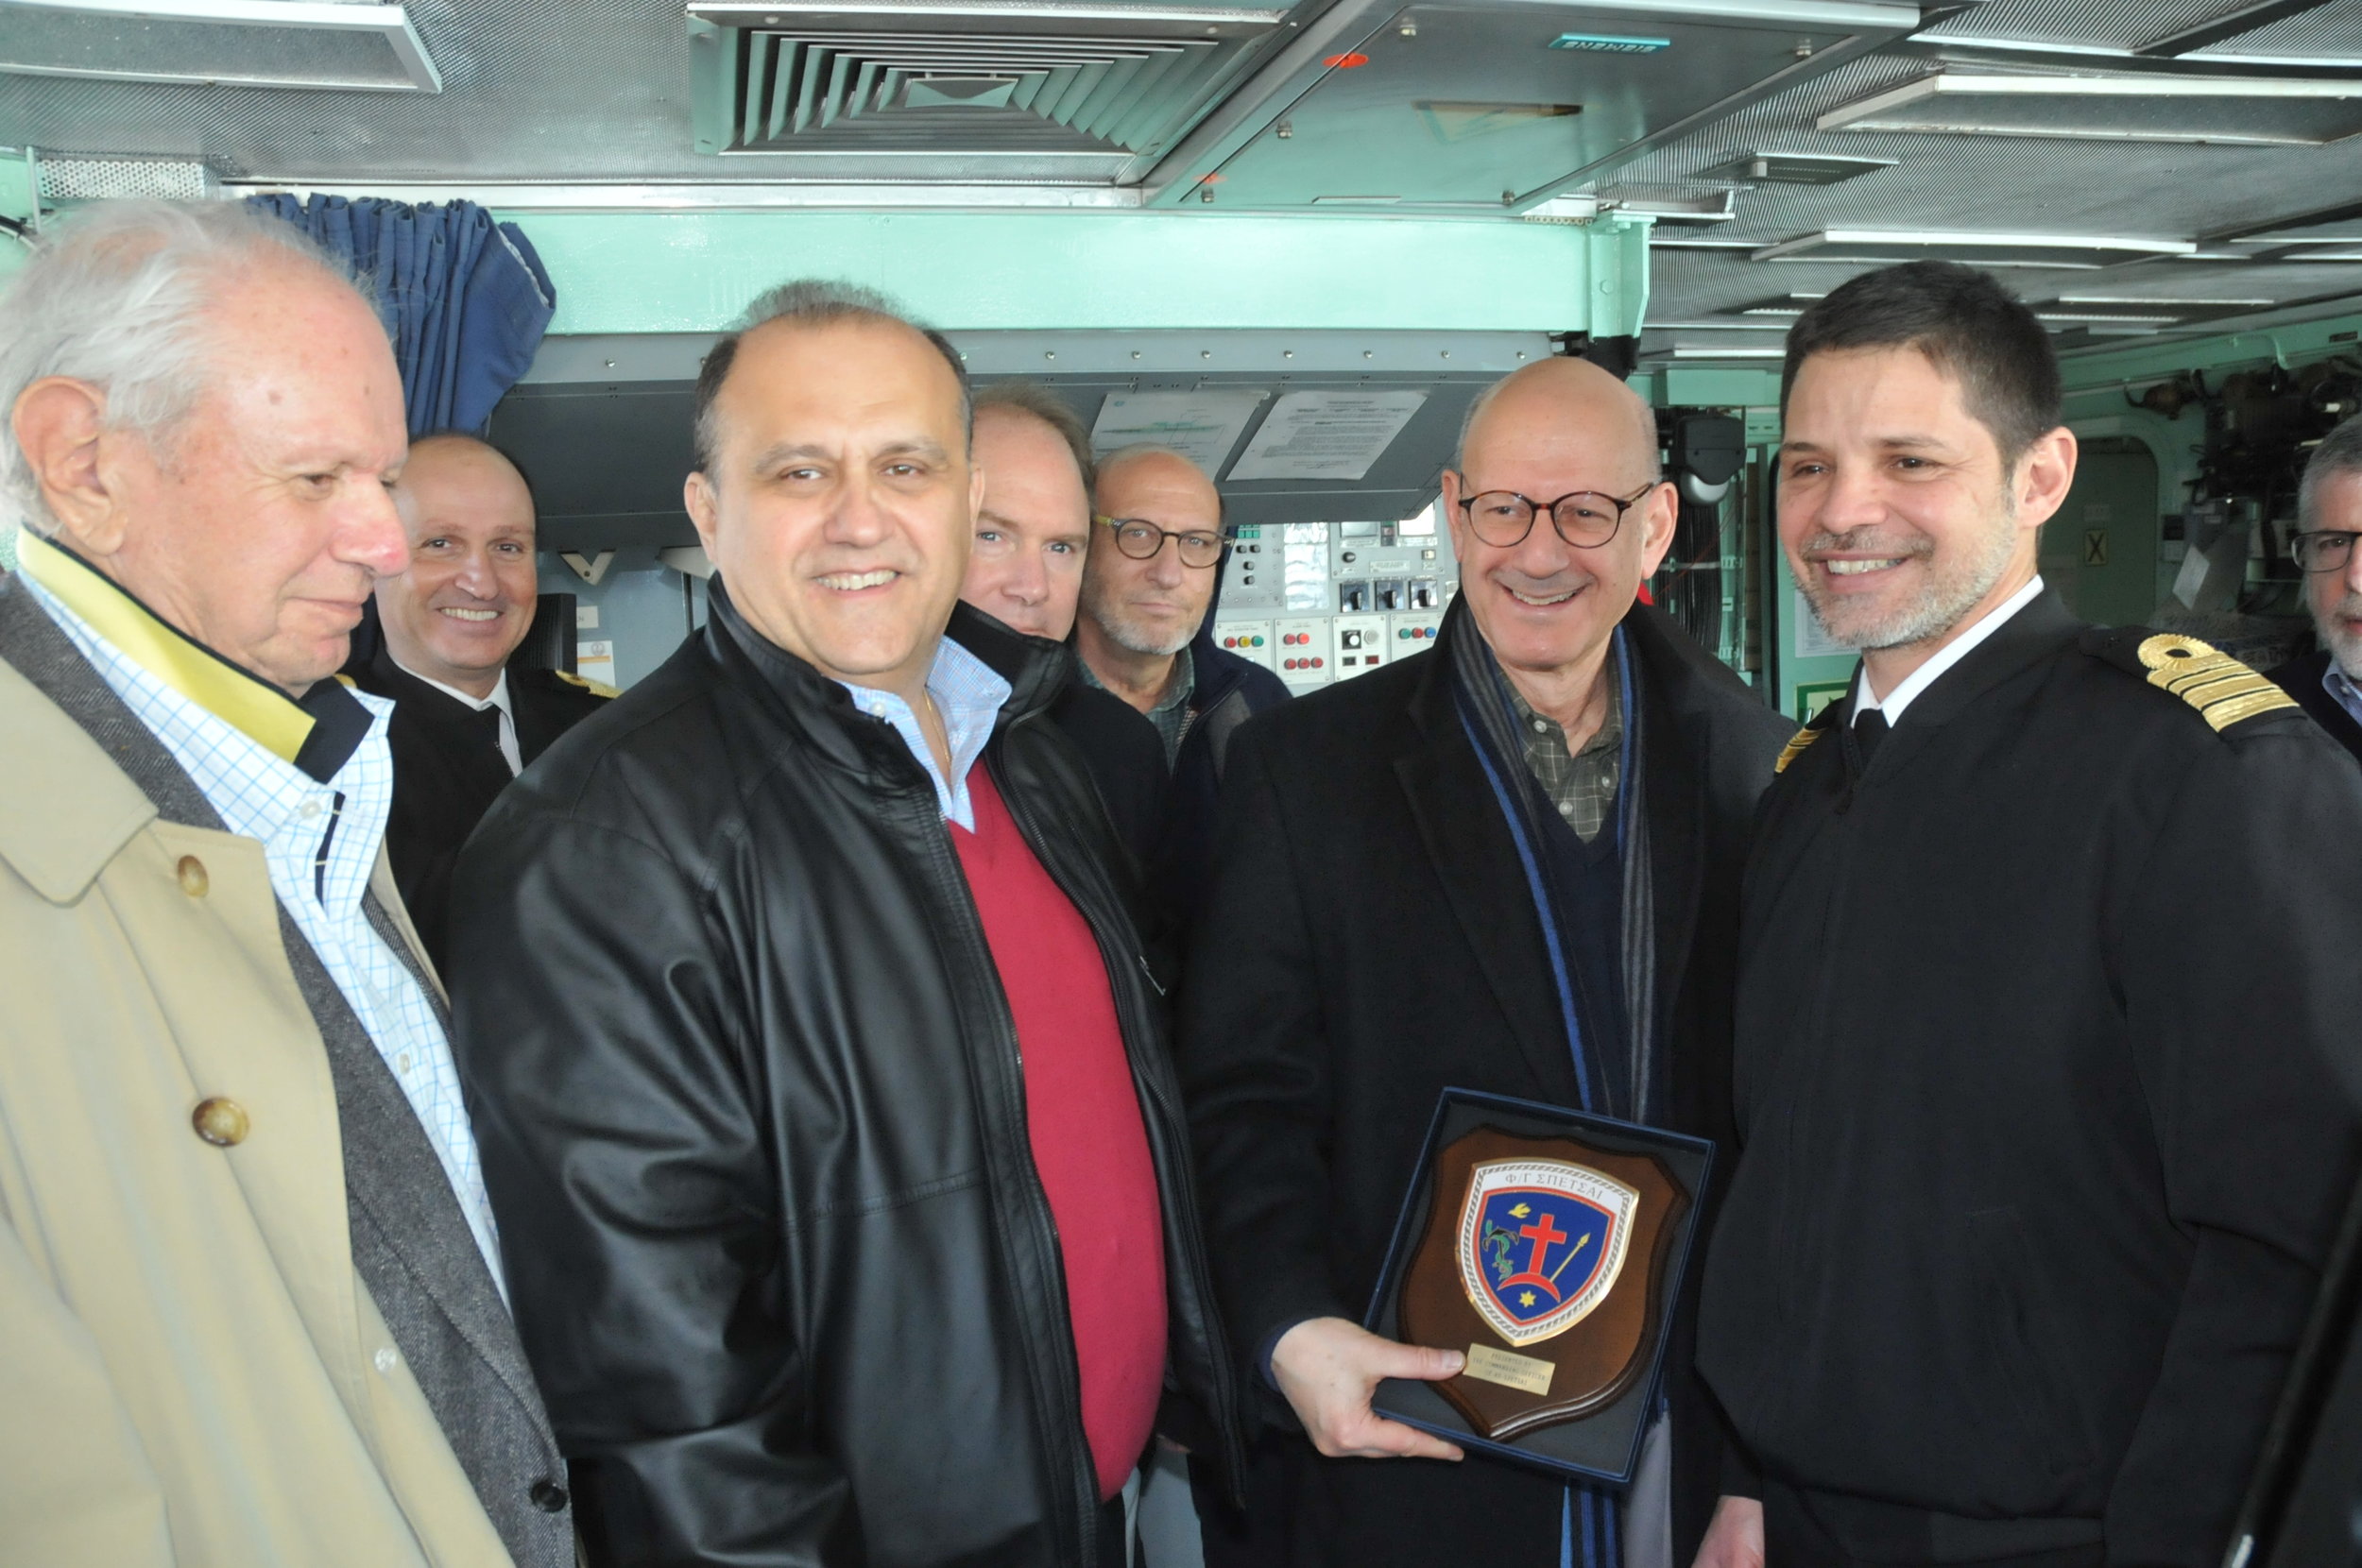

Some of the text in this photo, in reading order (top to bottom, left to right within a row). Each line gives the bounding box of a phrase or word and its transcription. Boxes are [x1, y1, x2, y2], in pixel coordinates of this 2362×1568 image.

[1562, 41, 1658, 53] SIEMENS
[1504, 1172, 1604, 1201] Φ/Γ ΣΠΕΤΣΑΙ
